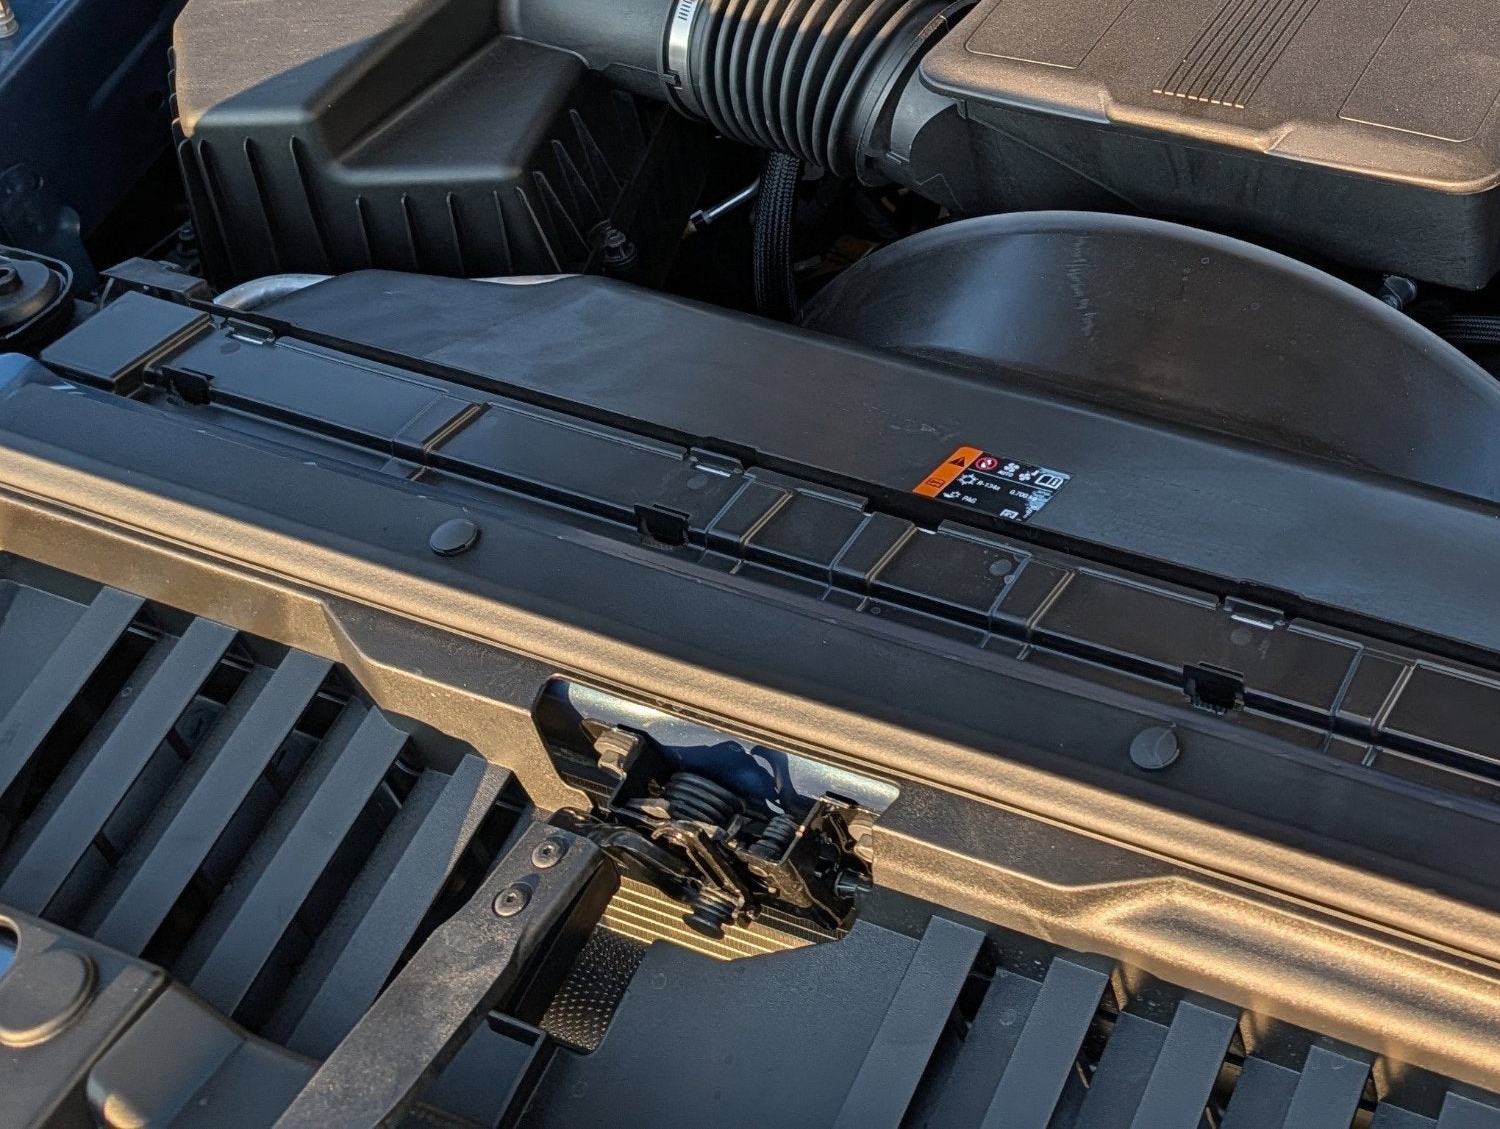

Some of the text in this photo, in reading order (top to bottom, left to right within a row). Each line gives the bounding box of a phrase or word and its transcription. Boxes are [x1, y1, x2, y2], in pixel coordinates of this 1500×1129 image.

[976, 480, 1001, 491] R-134a
[1009, 489, 1029, 500] 0.700
[961, 495, 978, 505] PAG
